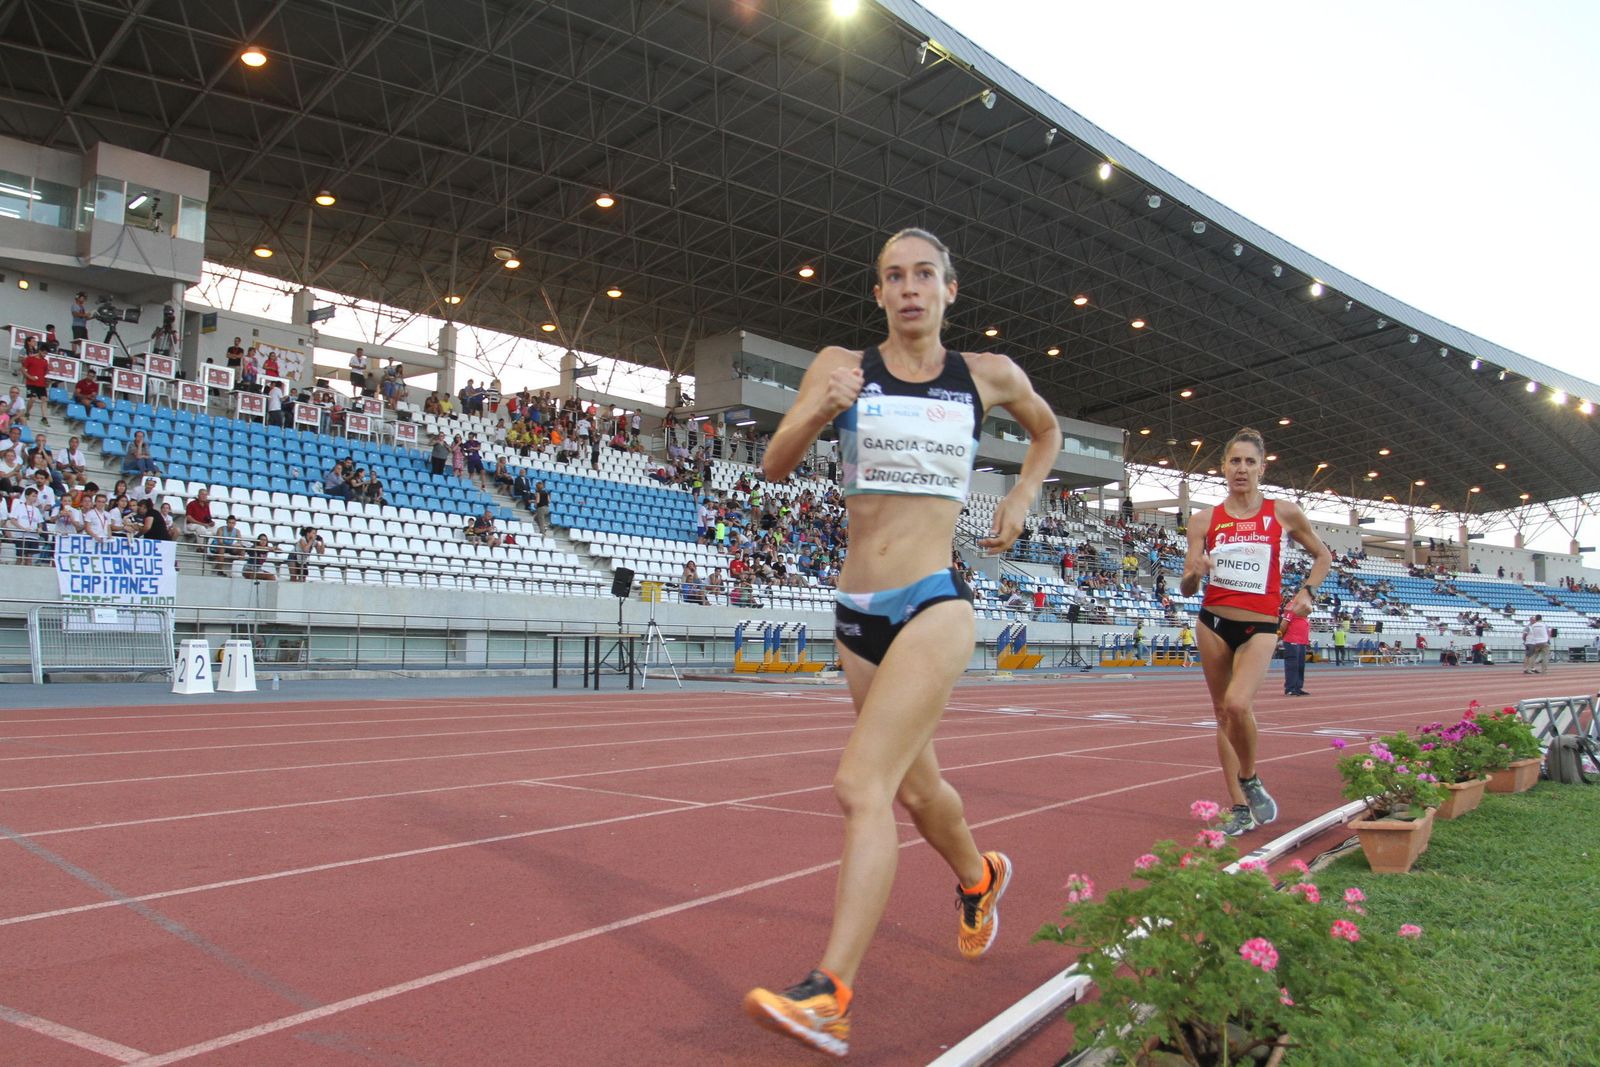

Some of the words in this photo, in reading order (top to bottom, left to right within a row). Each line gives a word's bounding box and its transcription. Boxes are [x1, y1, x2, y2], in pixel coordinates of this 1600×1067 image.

[863, 437, 966, 457] GARCIA-CARO
[1228, 531, 1270, 543] alquiber
[143, 539, 162, 557] DE
[58, 555, 101, 574] LEPE
[102, 556, 133, 575] CON
[134, 557, 163, 576] SUS
[1216, 558, 1260, 572] PINEDO
[1213, 575, 1262, 589] BRIDGESTONE
[178, 657, 187, 683] 2
[195, 654, 206, 680] 2
[227, 653, 233, 679] 1
[243, 654, 249, 679] 1
